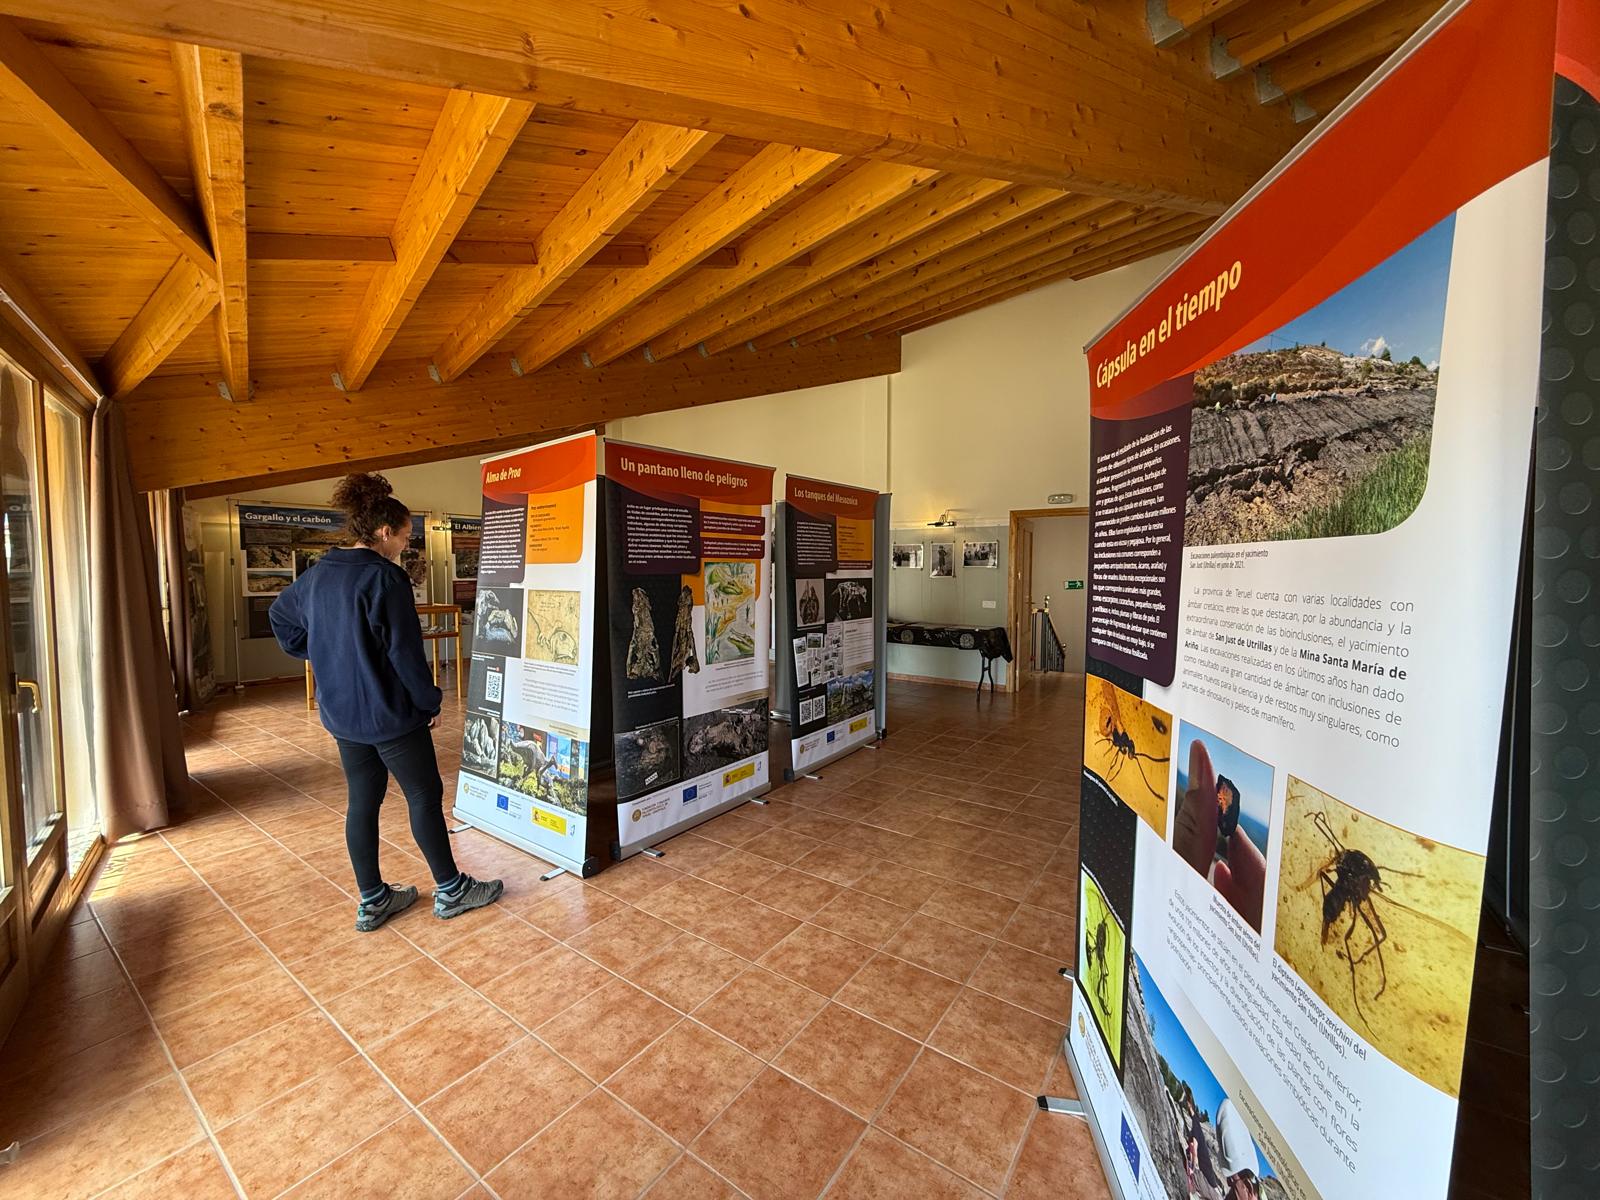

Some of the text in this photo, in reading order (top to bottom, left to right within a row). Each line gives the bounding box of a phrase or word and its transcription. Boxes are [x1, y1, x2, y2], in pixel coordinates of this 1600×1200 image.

[1096, 260, 1241, 388] Cápsula en el tiempo
[486, 467, 521, 484] Alma de Proa
[621, 457, 748, 488] Un pantano lleno de peligros
[794, 488, 804, 497] Los
[805, 490, 826, 502] tanques
[245, 512, 283, 521] Gargallo
[1245, 550, 1268, 559] yacimiento
[1226, 605, 1240, 614] entre
[1252, 609, 1263, 618] que
[1266, 610, 1300, 622] destacan,
[1303, 614, 1316, 624] por
[1320, 613, 1326, 624] la
[1329, 615, 1382, 631] abundancia
[1387, 624, 1395, 636] y
[1400, 621, 1411, 635] la
[1236, 589, 1252, 598] Teruel
[1256, 592, 1279, 601] cuenta
[1284, 594, 1297, 603] con
[1303, 594, 1324, 605] varias
[1331, 594, 1381, 609] localidades
[1390, 601, 1414, 611] con
[1209, 632, 1214, 640] de
[1216, 633, 1224, 641] San
[1225, 635, 1236, 644] Just
[1237, 637, 1245, 646] de
[1247, 639, 1272, 652] Utrillas
[1273, 647, 1278, 655] y
[1280, 646, 1289, 656] de
[1291, 646, 1297, 657] la
[1300, 649, 1320, 662] Mina
[1323, 654, 1348, 668] Santa
[1352, 660, 1384, 676] María
[1389, 666, 1407, 680] de
[1220, 620, 1253, 631] conservación
[1256, 624, 1264, 634] de
[1267, 626, 1276, 636] las
[1280, 626, 1334, 647] bioinclusiones,
[1338, 636, 1345, 647] el
[1349, 640, 1409, 657] yacimiento
[1184, 655, 1196, 663] como
[1198, 659, 1219, 671] resultado
[1231, 669, 1242, 678] gran
[1244, 672, 1271, 686] cantidad
[1274, 680, 1282, 689] de
[1285, 682, 1308, 697] ámbar
[1311, 691, 1325, 703] con
[1329, 695, 1380, 719] inclusiones
[1386, 711, 1402, 725] de
[1210, 648, 1240, 661] excavaciones
[1241, 655, 1271, 669] realizadas
[1274, 663, 1282, 671] en
[1286, 664, 1295, 675] los
[1298, 667, 1325, 683] últimos
[1328, 675, 1347, 689] años
[1351, 680, 1368, 694] han
[1373, 686, 1404, 702] dado
[1182, 682, 1198, 692] plumas
[1207, 689, 1230, 705] dinosaurio
[1230, 701, 1234, 709] y
[1235, 702, 1250, 713] pelos
[1251, 707, 1259, 717] de
[1261, 712, 1295, 731] mamífero.
[1204, 675, 1220, 686] nuevos
[1221, 681, 1231, 690] para
[1233, 684, 1237, 692] la
[1238, 687, 1258, 699] ciencia
[1259, 694, 1263, 703] y
[1265, 695, 1273, 705] de
[1276, 699, 1298, 712] restos
[1300, 706, 1315, 721] muy
[1318, 712, 1362, 737] singulares,
[1366, 730, 1399, 747] como
[1271, 971, 1347, 1059] yacimiento San Just (Utrillas).
[1273, 957, 1277, 968] El
[1294, 981, 1325, 1020] Leptoconops
[1325, 1018, 1353, 1047] zerichini
[1354, 1043, 1366, 1061] del
[1272, 1019, 1360, 1131] Esa edad es clave en la
[1293, 1026, 1325, 1070] Cretácico
[1326, 1066, 1362, 1112] Inferior,
[1288, 1060, 1311, 1097] plantas
[1313, 1095, 1328, 1118] con
[1330, 1114, 1358, 1153] flores
[1320, 1125, 1355, 1174] durante
